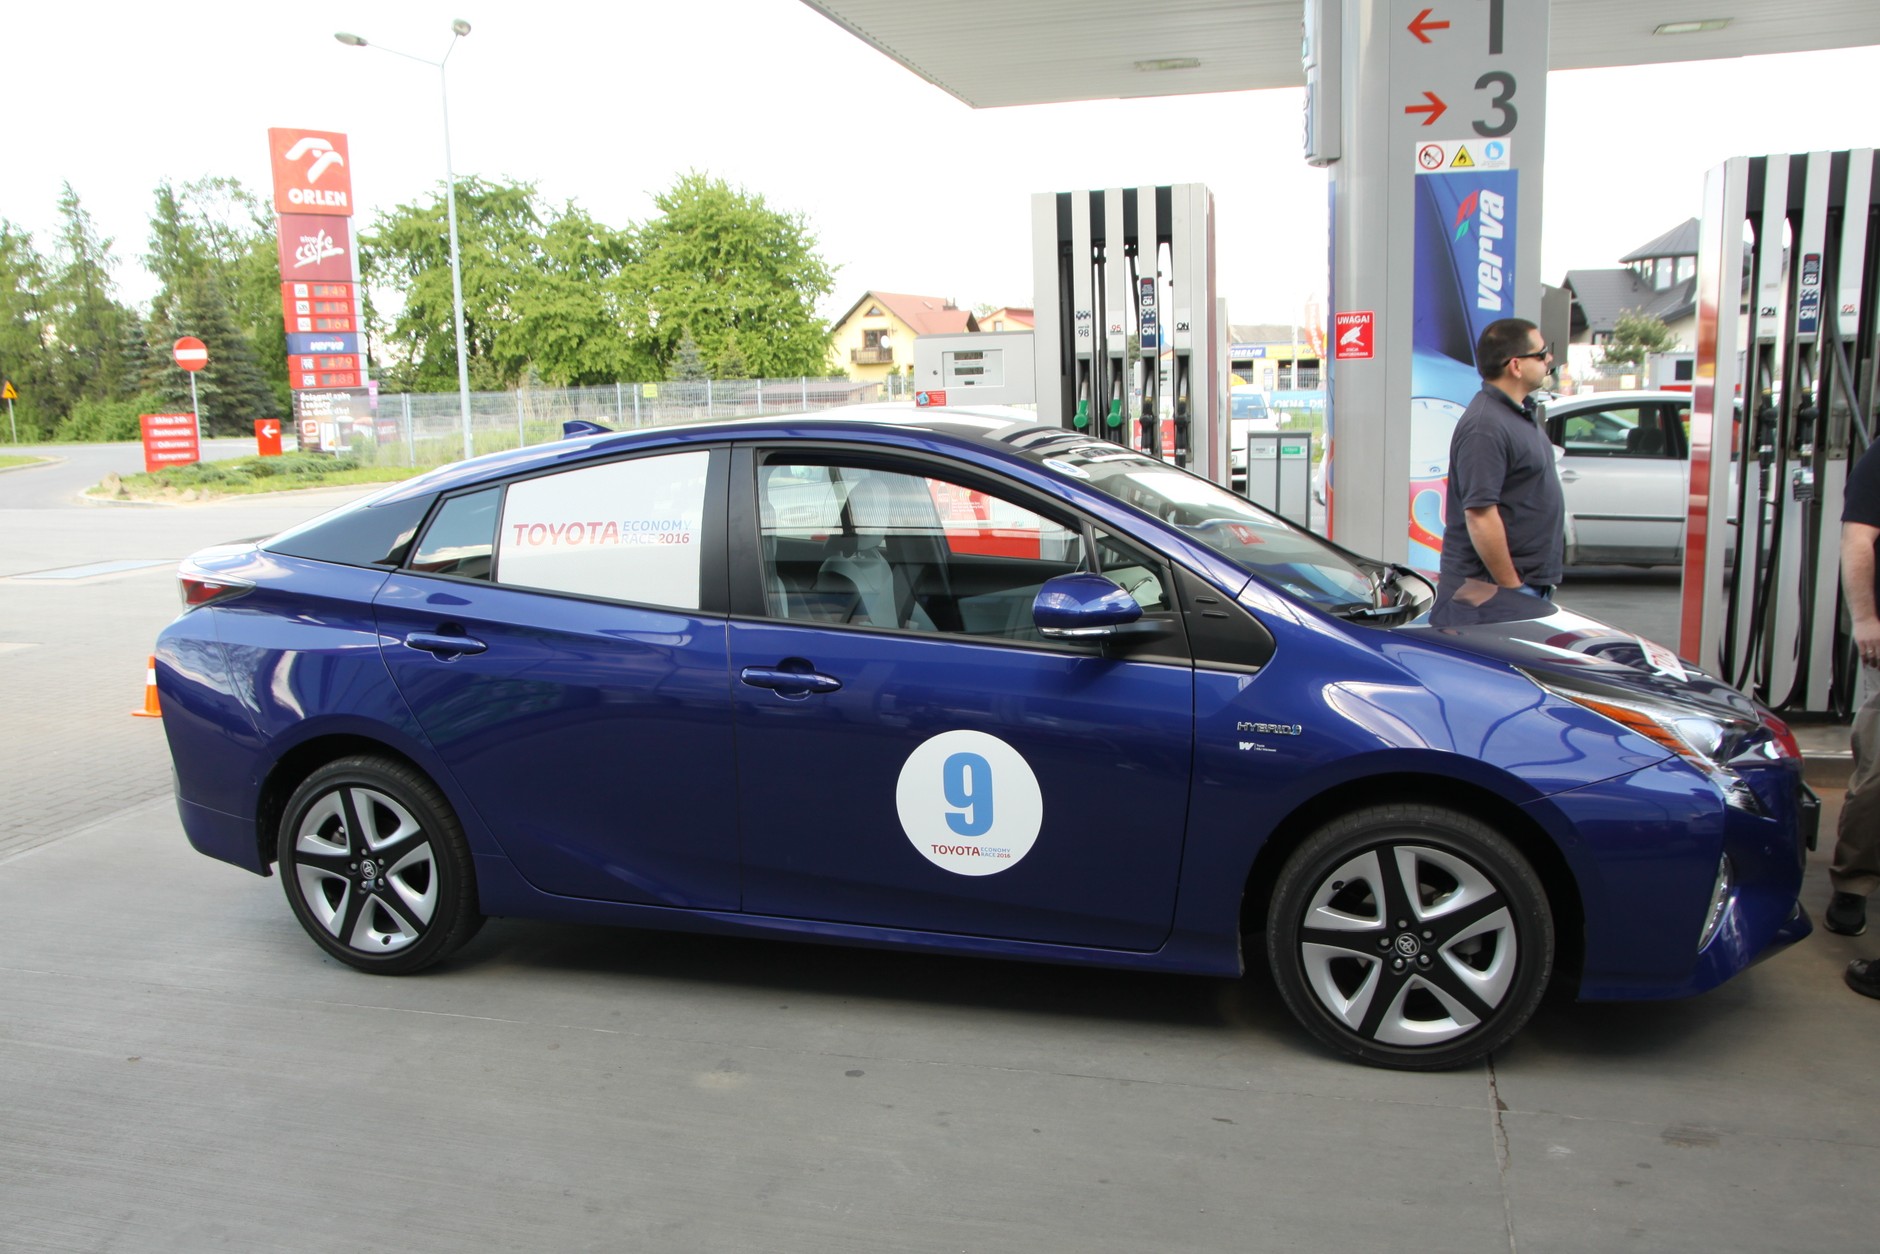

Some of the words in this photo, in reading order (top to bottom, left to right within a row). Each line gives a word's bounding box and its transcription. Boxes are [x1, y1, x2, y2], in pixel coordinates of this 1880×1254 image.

[1487, 0, 1504, 55] 1
[1472, 70, 1518, 138] 3
[288, 188, 348, 207] ORLEN
[1477, 189, 1504, 311] verva
[1338, 315, 1370, 325] UWAGA!
[1800, 309, 1816, 320] ON
[1078, 329, 1089, 337] 98
[1142, 327, 1155, 336] ON
[310, 341, 345, 351] verva
[622, 520, 692, 531] ECONOMY
[513, 521, 619, 546] TOYOTA
[621, 533, 656, 544] RACE
[658, 533, 690, 544] 2016
[1237, 721, 1292, 735] HYBRID
[943, 752, 993, 836] 9
[931, 844, 980, 856] TOYOTA
